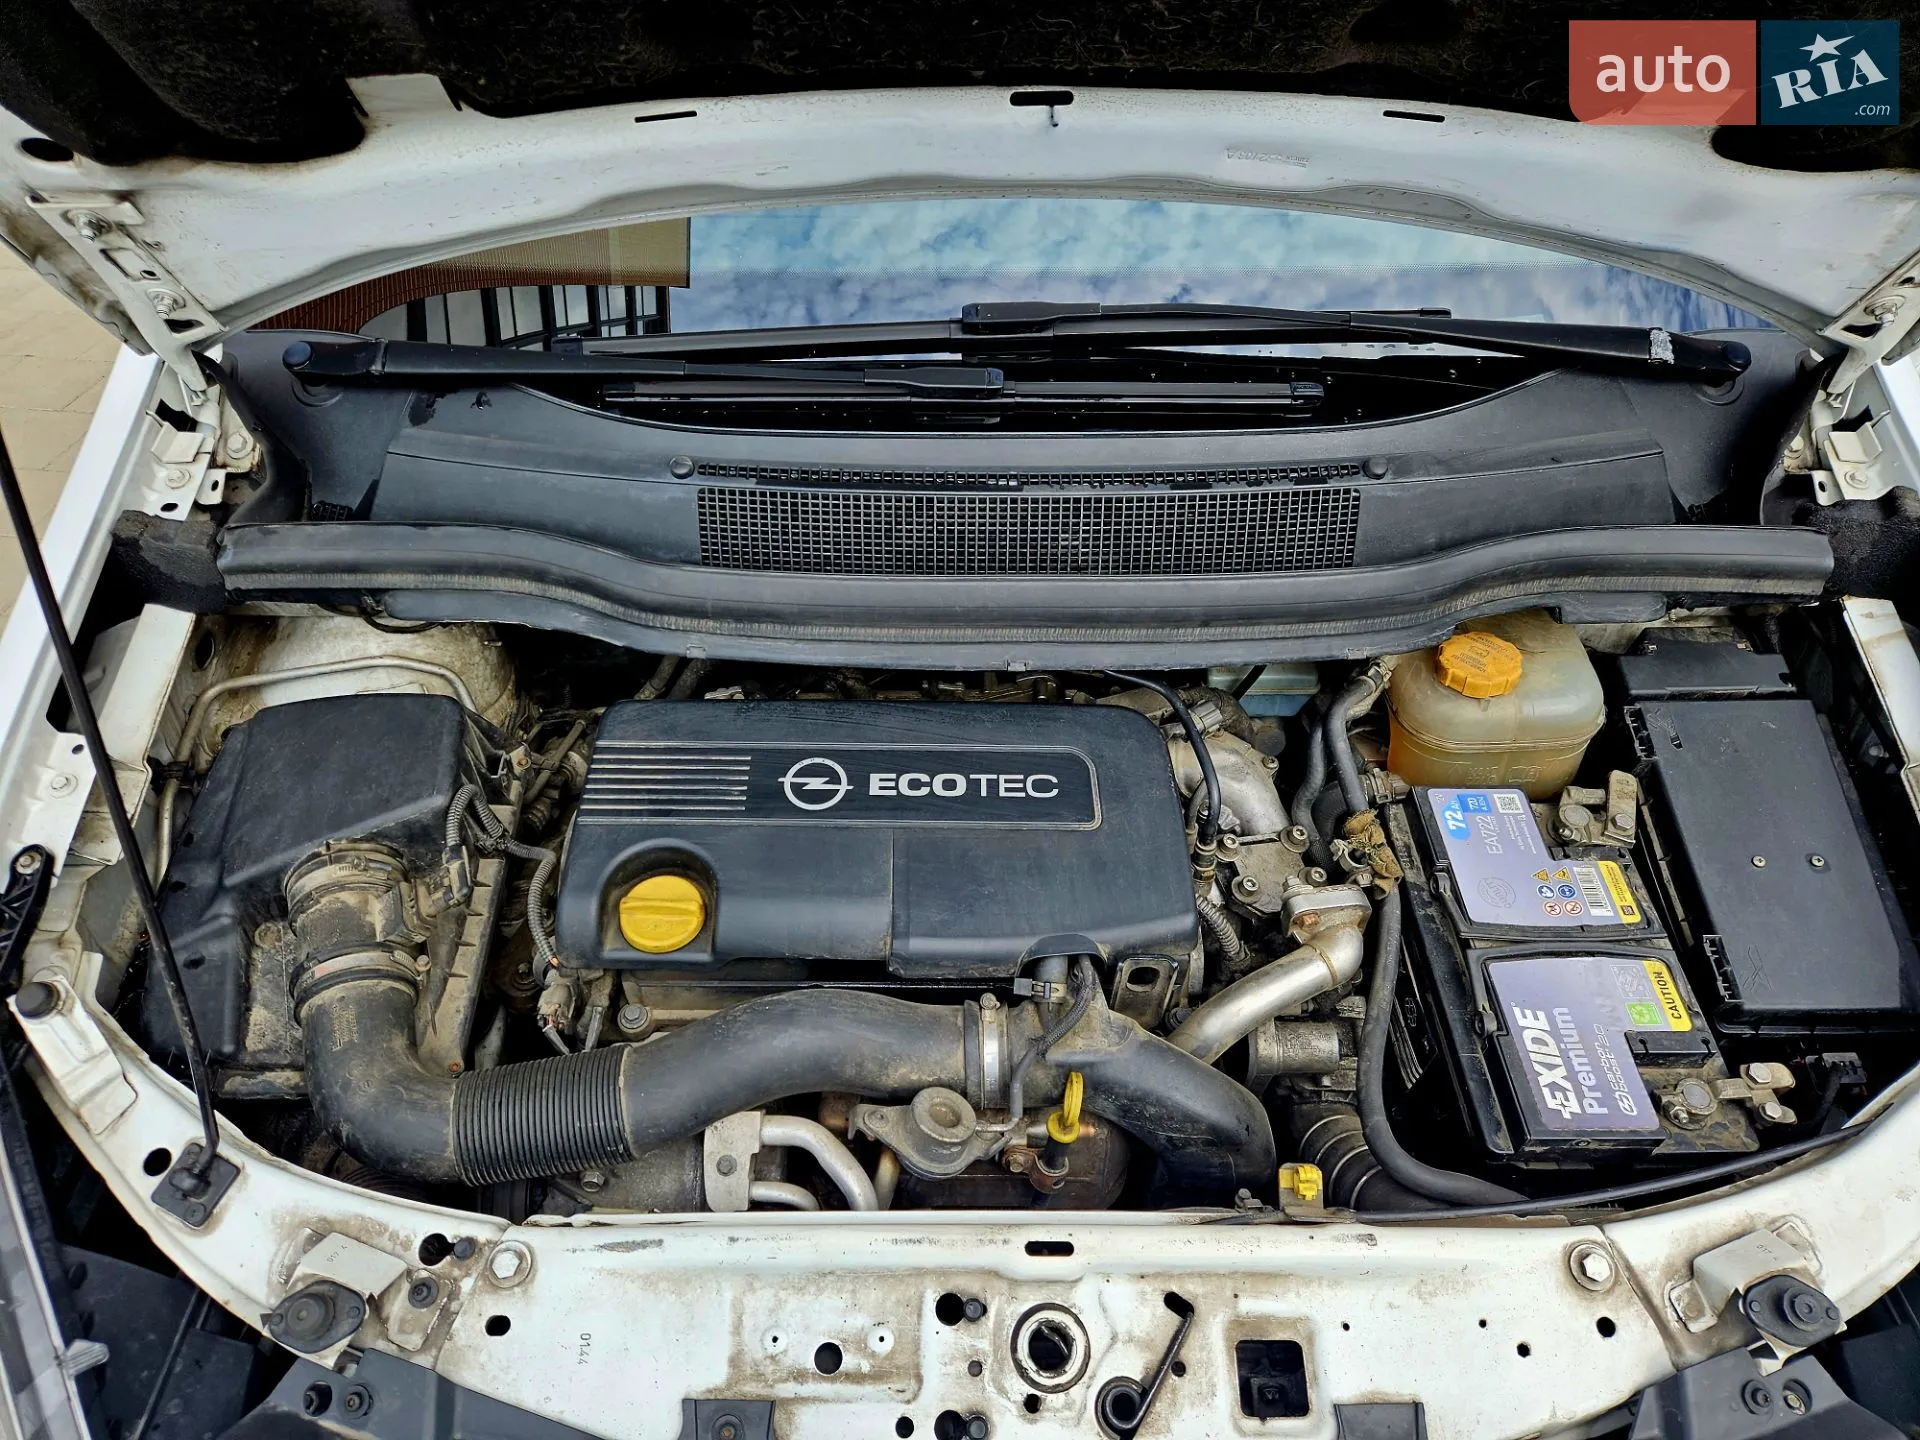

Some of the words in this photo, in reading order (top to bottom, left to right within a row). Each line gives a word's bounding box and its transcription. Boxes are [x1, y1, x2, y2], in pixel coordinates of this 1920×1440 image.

[869, 773, 1059, 798] ECOTEC
[1444, 810, 1467, 830] 72
[1476, 815, 1504, 854] EA722
[1653, 971, 1682, 1020] CAUTION
[1512, 1006, 1582, 1120] EXIDE
[1552, 1007, 1609, 1114] Premium
